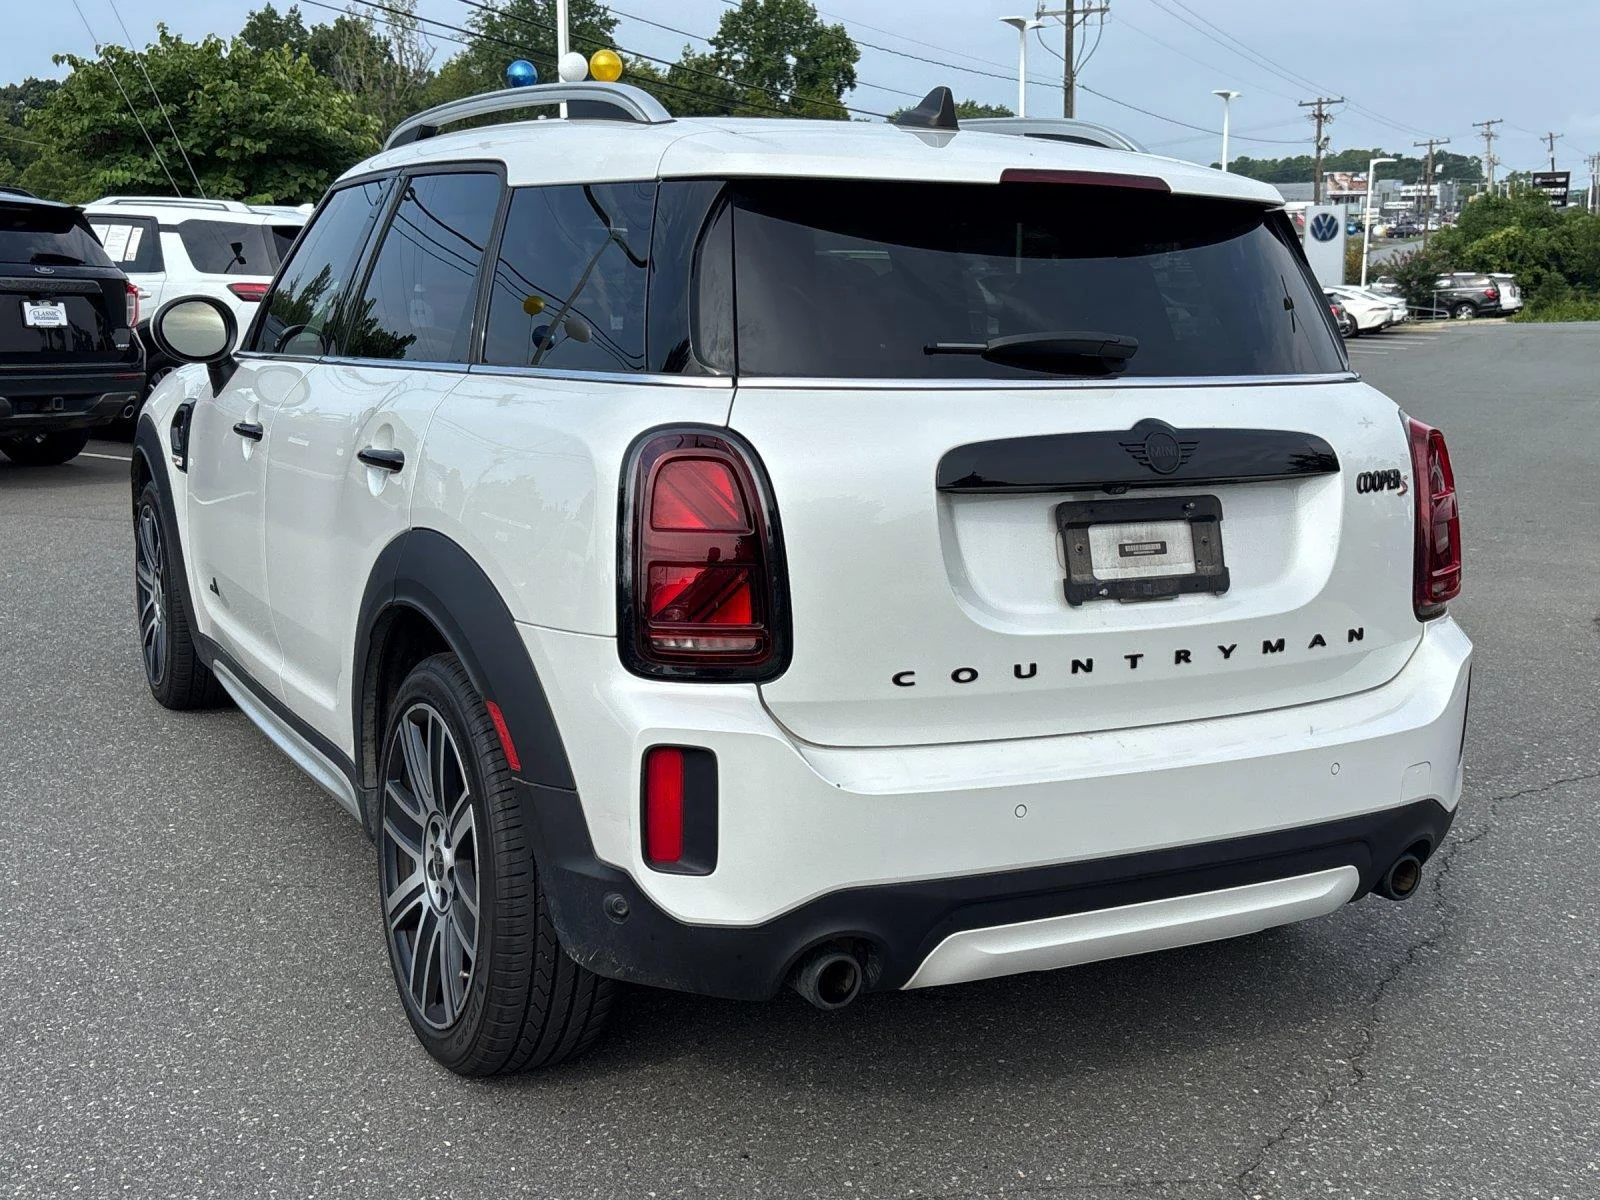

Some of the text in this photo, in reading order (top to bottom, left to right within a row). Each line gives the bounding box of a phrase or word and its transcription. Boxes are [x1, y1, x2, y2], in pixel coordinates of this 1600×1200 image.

[1150, 445, 1177, 457] MINI
[1356, 469, 1401, 494] COOPER
[892, 626, 1366, 688] COUNTRYMAN
